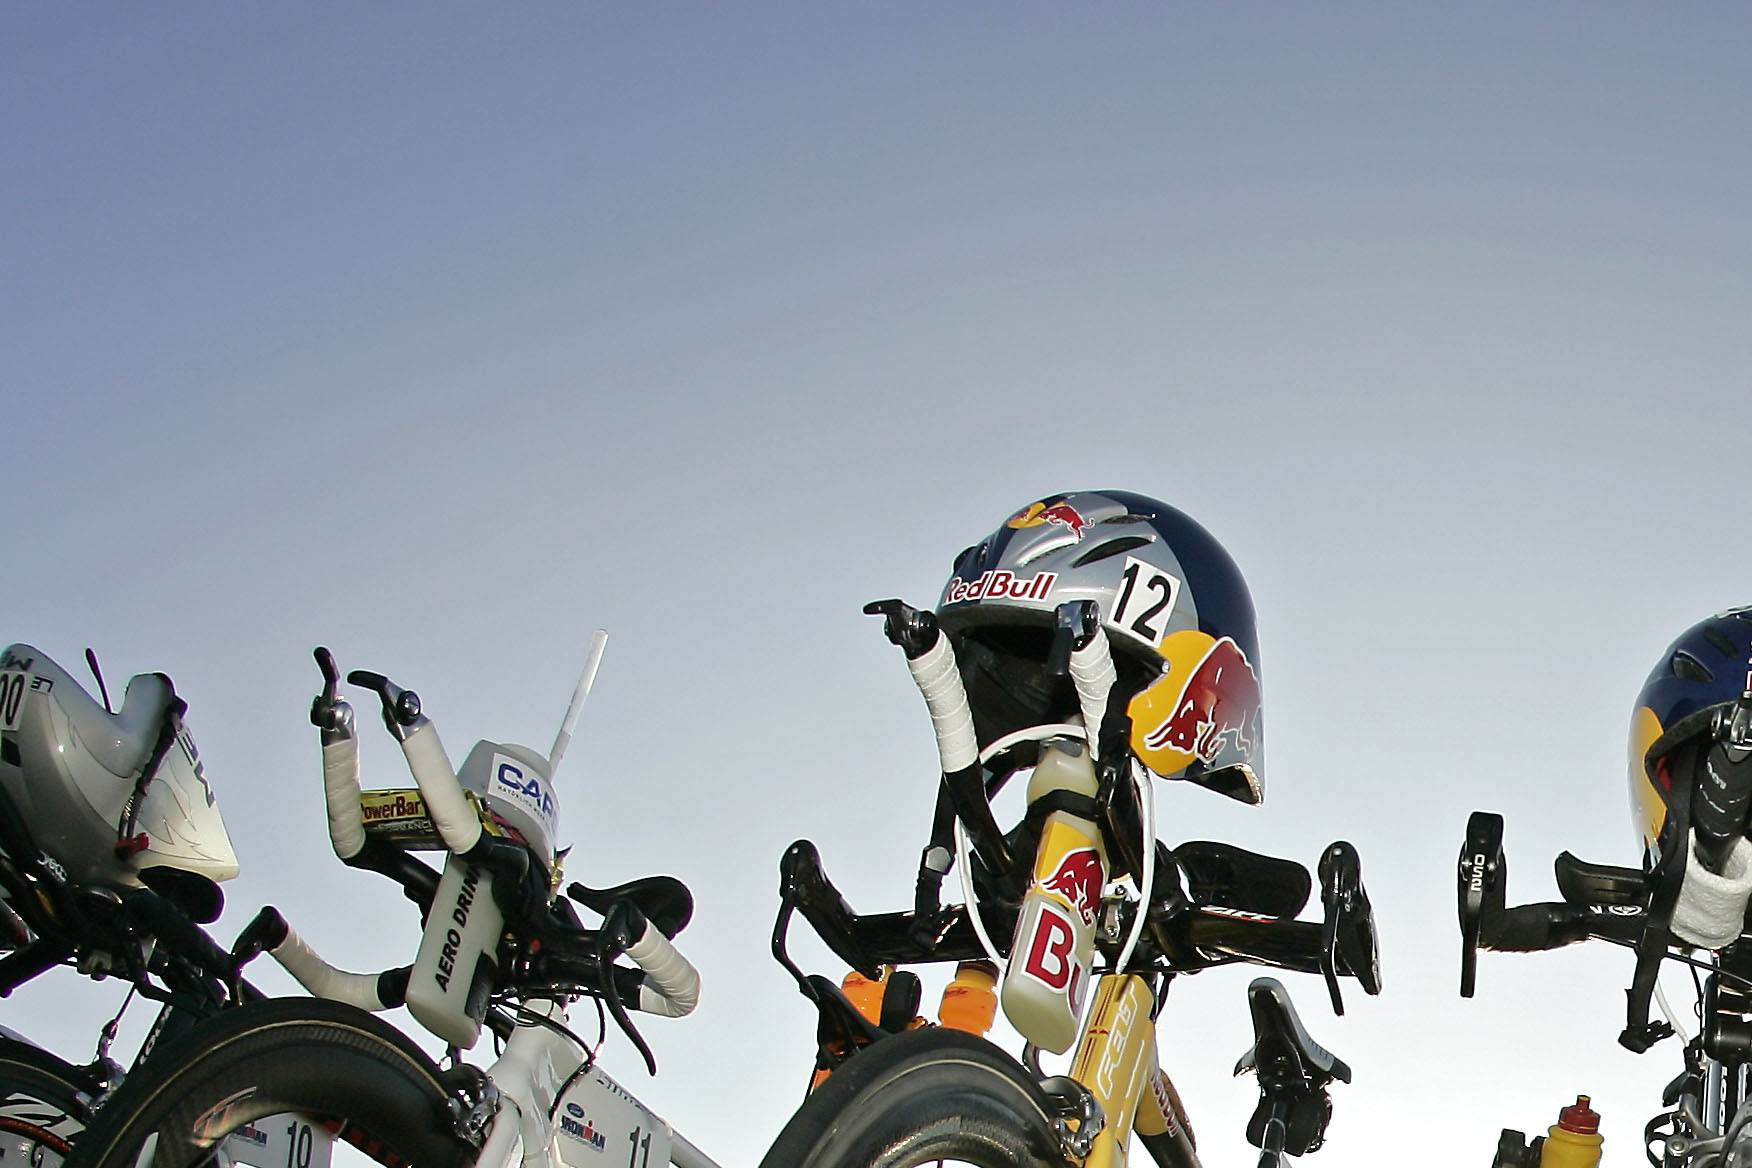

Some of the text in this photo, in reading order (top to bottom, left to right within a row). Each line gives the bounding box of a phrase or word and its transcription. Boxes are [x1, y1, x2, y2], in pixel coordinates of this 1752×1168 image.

[947, 570, 1060, 604] Red Bull
[1113, 562, 1172, 642] 12
[434, 929, 462, 993] AERO
